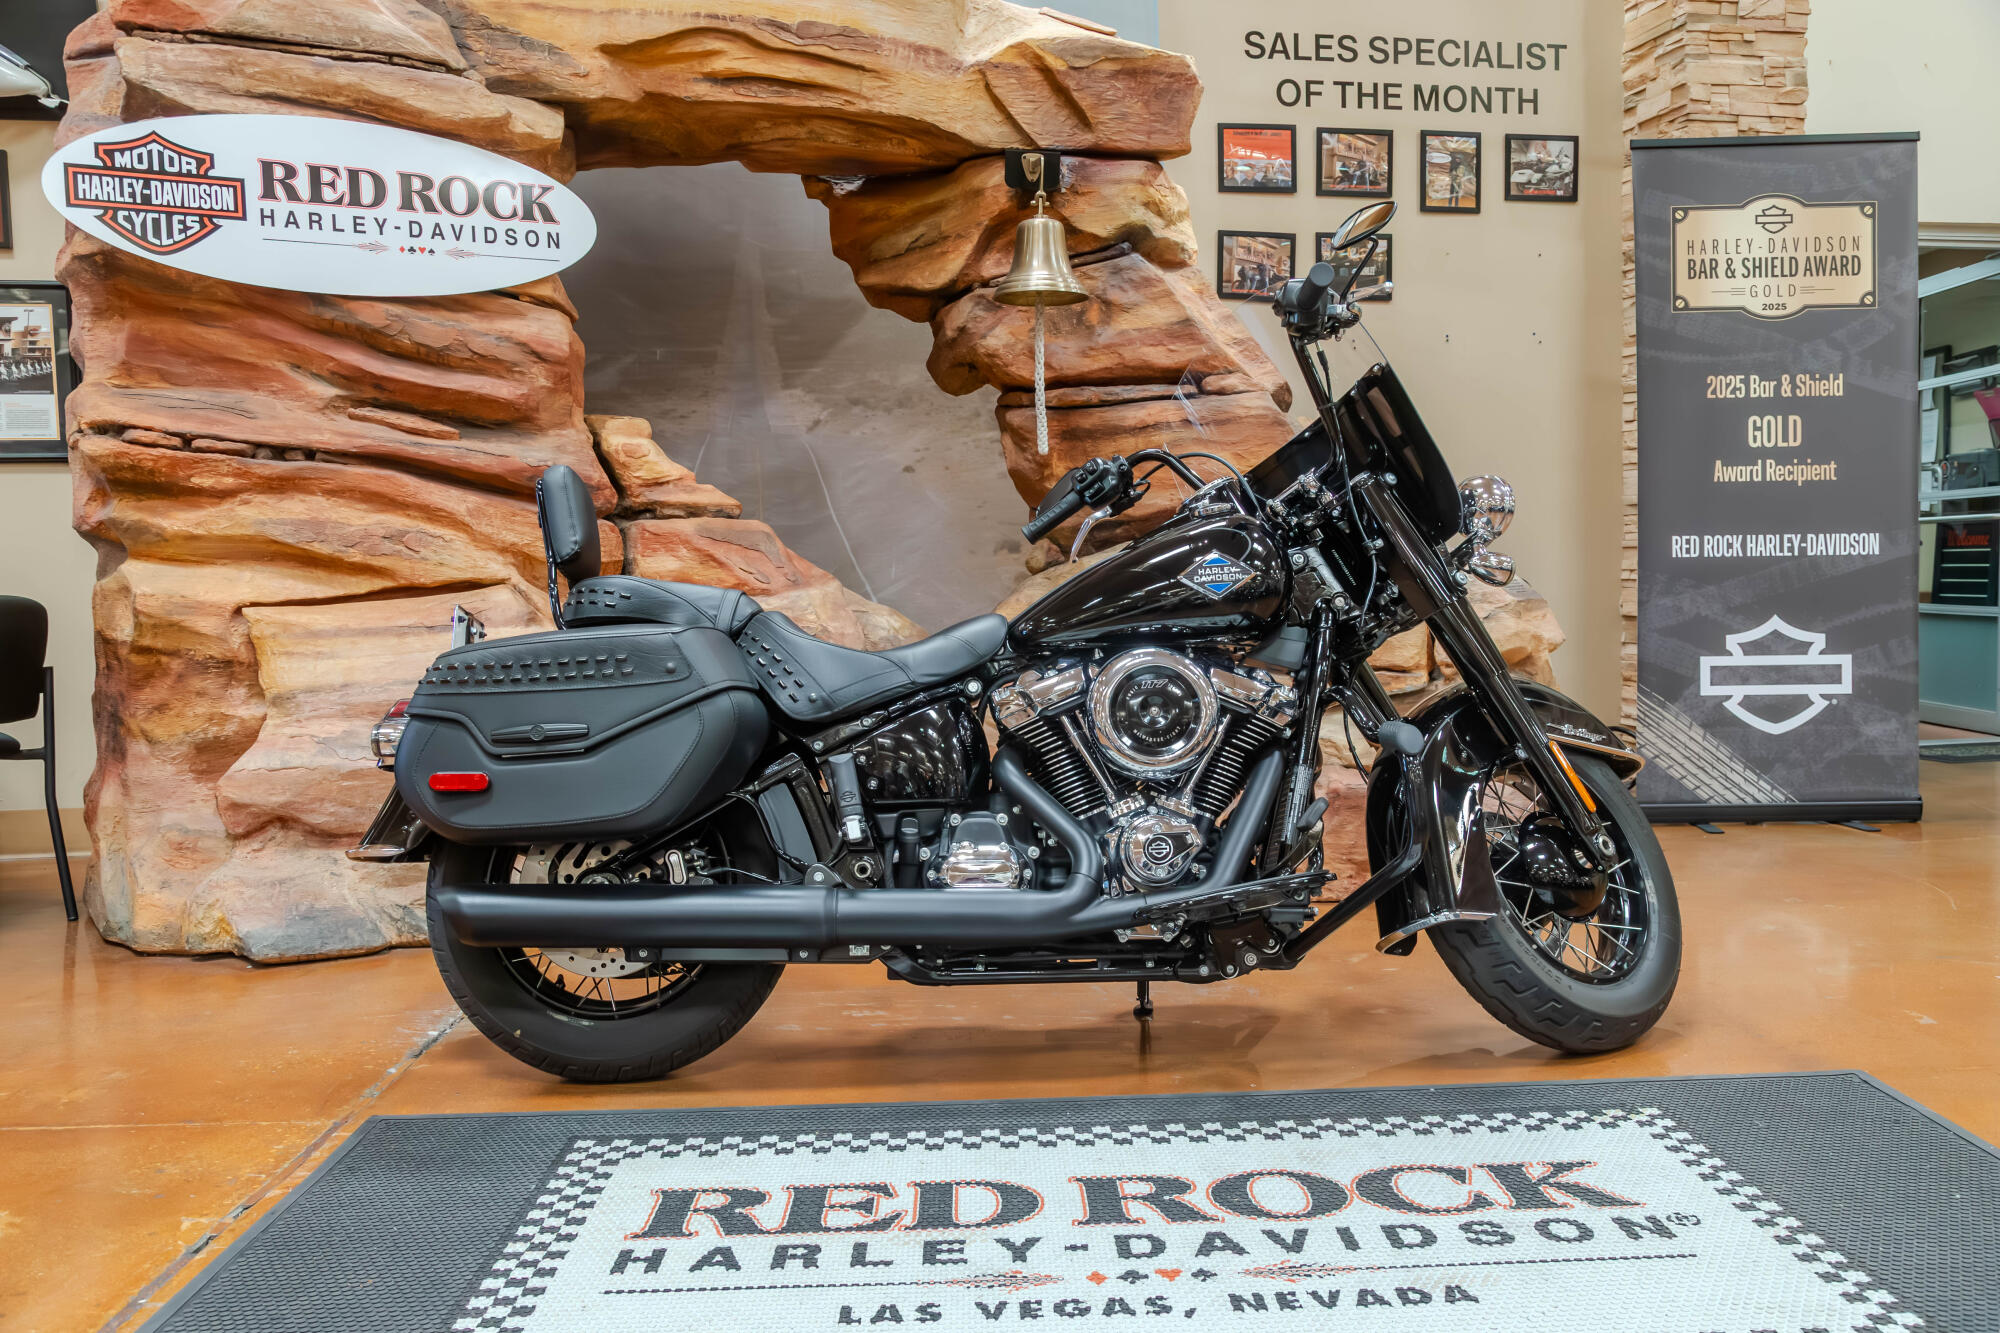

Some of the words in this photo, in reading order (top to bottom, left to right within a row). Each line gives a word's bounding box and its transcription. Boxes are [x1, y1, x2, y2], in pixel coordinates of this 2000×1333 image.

[1244, 30, 1359, 63] SALES
[1368, 36, 1568, 71] SPECIALIST
[1276, 78, 1324, 108] OF
[1333, 81, 1403, 111] THE
[1413, 84, 1539, 115] MONTH
[114, 142, 198, 175] MOTOR
[77, 173, 235, 212] HARLEY-DAVIDSON
[256, 157, 388, 211] RED
[396, 170, 561, 226] ROCK
[117, 209, 201, 248] CYCLES
[260, 208, 561, 250] HARLEY-DAVIDSON
[1687, 235, 1861, 256] HARLEY-DAVIDSON
[1687, 257, 1719, 280] BAR
[1725, 257, 1736, 279] &
[1741, 256, 1799, 279] SHIELD
[1803, 255, 1861, 277] AWARD
[1750, 284, 1797, 298] GOLD
[1762, 302, 1787, 311] 2025
[1706, 375, 1745, 399] 2025
[1750, 374, 1777, 398] Bar
[1781, 374, 1792, 397] &
[1796, 373, 1843, 397] Shield
[1748, 415, 1802, 448] GOLD
[1713, 459, 1762, 483] Award
[1766, 458, 1837, 486] Recipient
[1671, 535, 1700, 558] RED
[1703, 534, 1743, 558] ROCK
[1746, 533, 1880, 557] HARLEY-DAVIDSON
[1141, 678, 1169, 689] 117
[623, 1181, 1045, 1241] RED
[1067, 1160, 1647, 1228] ROCK
[838, 1302, 943, 1326] LAS
[974, 1295, 1197, 1323] VEGAS,
[1227, 1283, 1480, 1312] NEVADA
